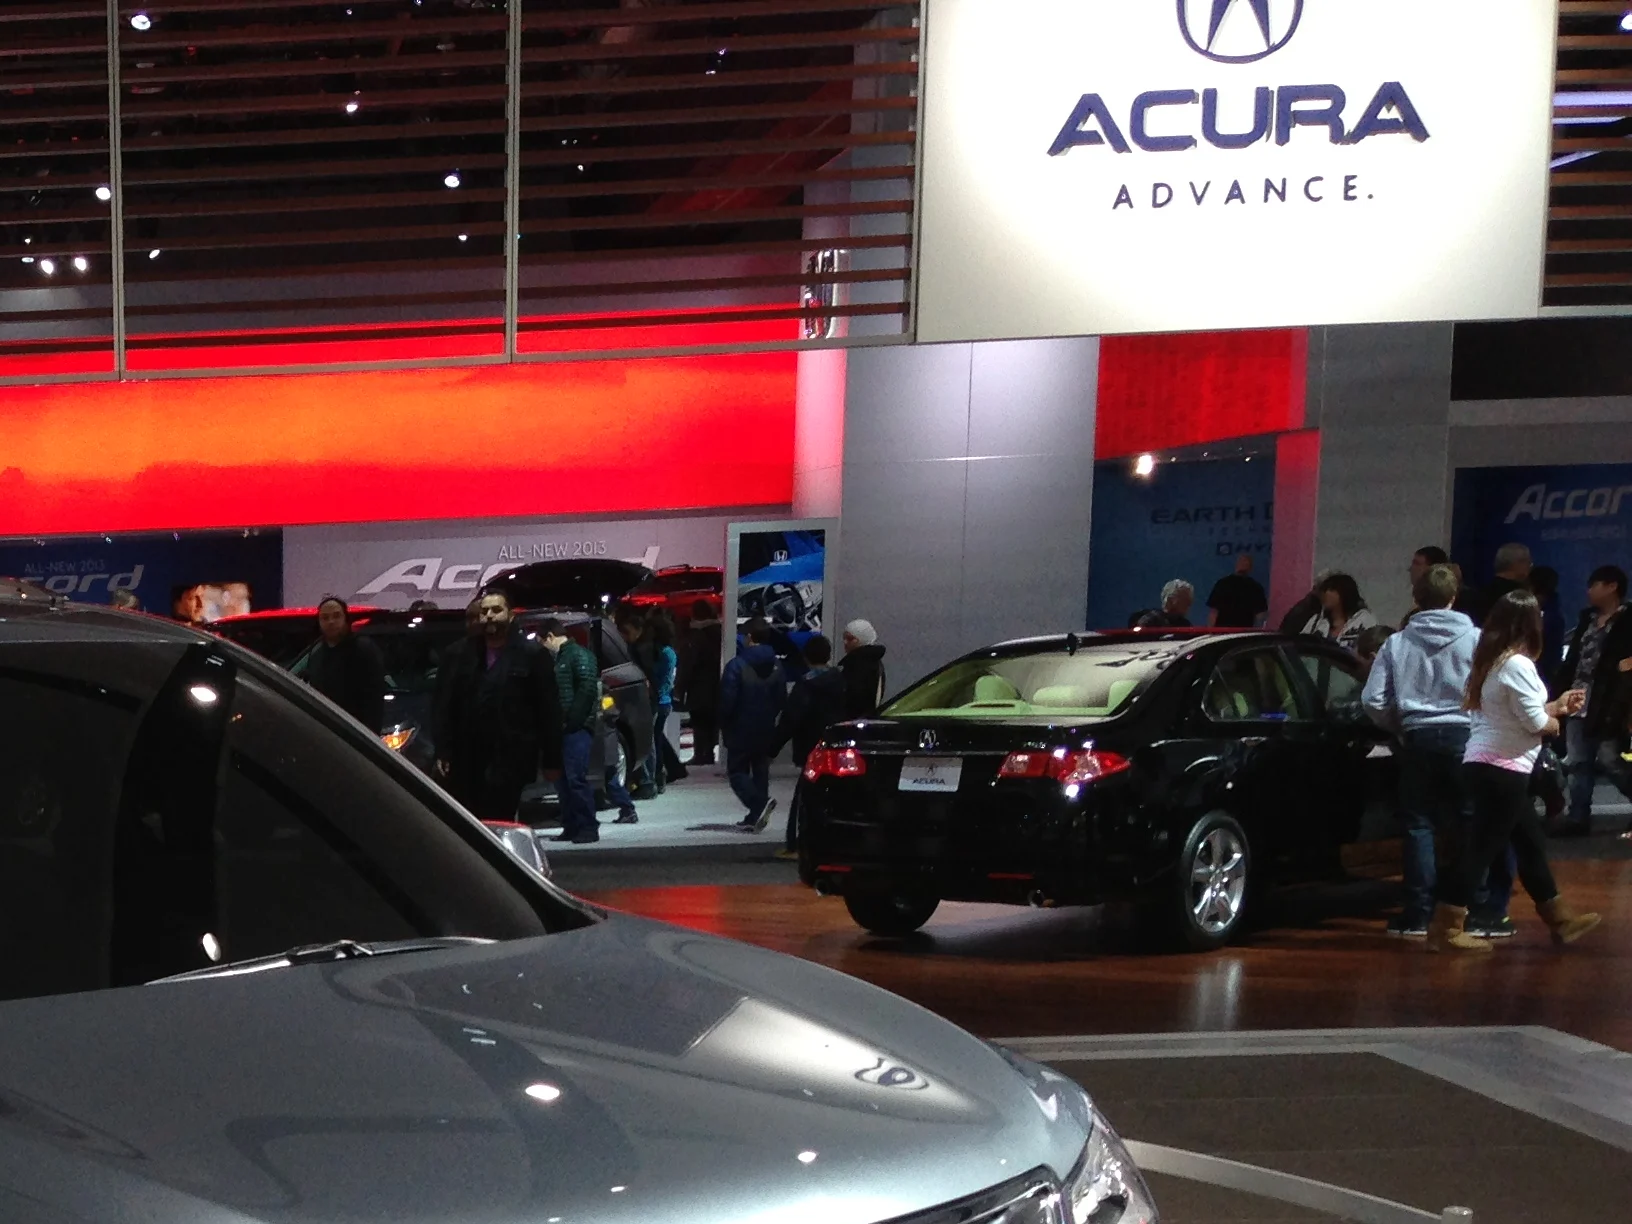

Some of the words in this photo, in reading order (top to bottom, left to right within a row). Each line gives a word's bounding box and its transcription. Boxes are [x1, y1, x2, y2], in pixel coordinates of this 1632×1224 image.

[1047, 81, 1431, 157] ACURA
[1112, 174, 1374, 211] ADVANCE.
[1503, 483, 1632, 524] Accor
[1150, 506, 1255, 524] EARTH
[498, 543, 568, 561] ALL-NEW
[572, 541, 607, 558] 2013
[24, 561, 76, 574] ALL-NEW
[79, 559, 106, 572] 2013
[913, 777, 946, 786] ACURA
